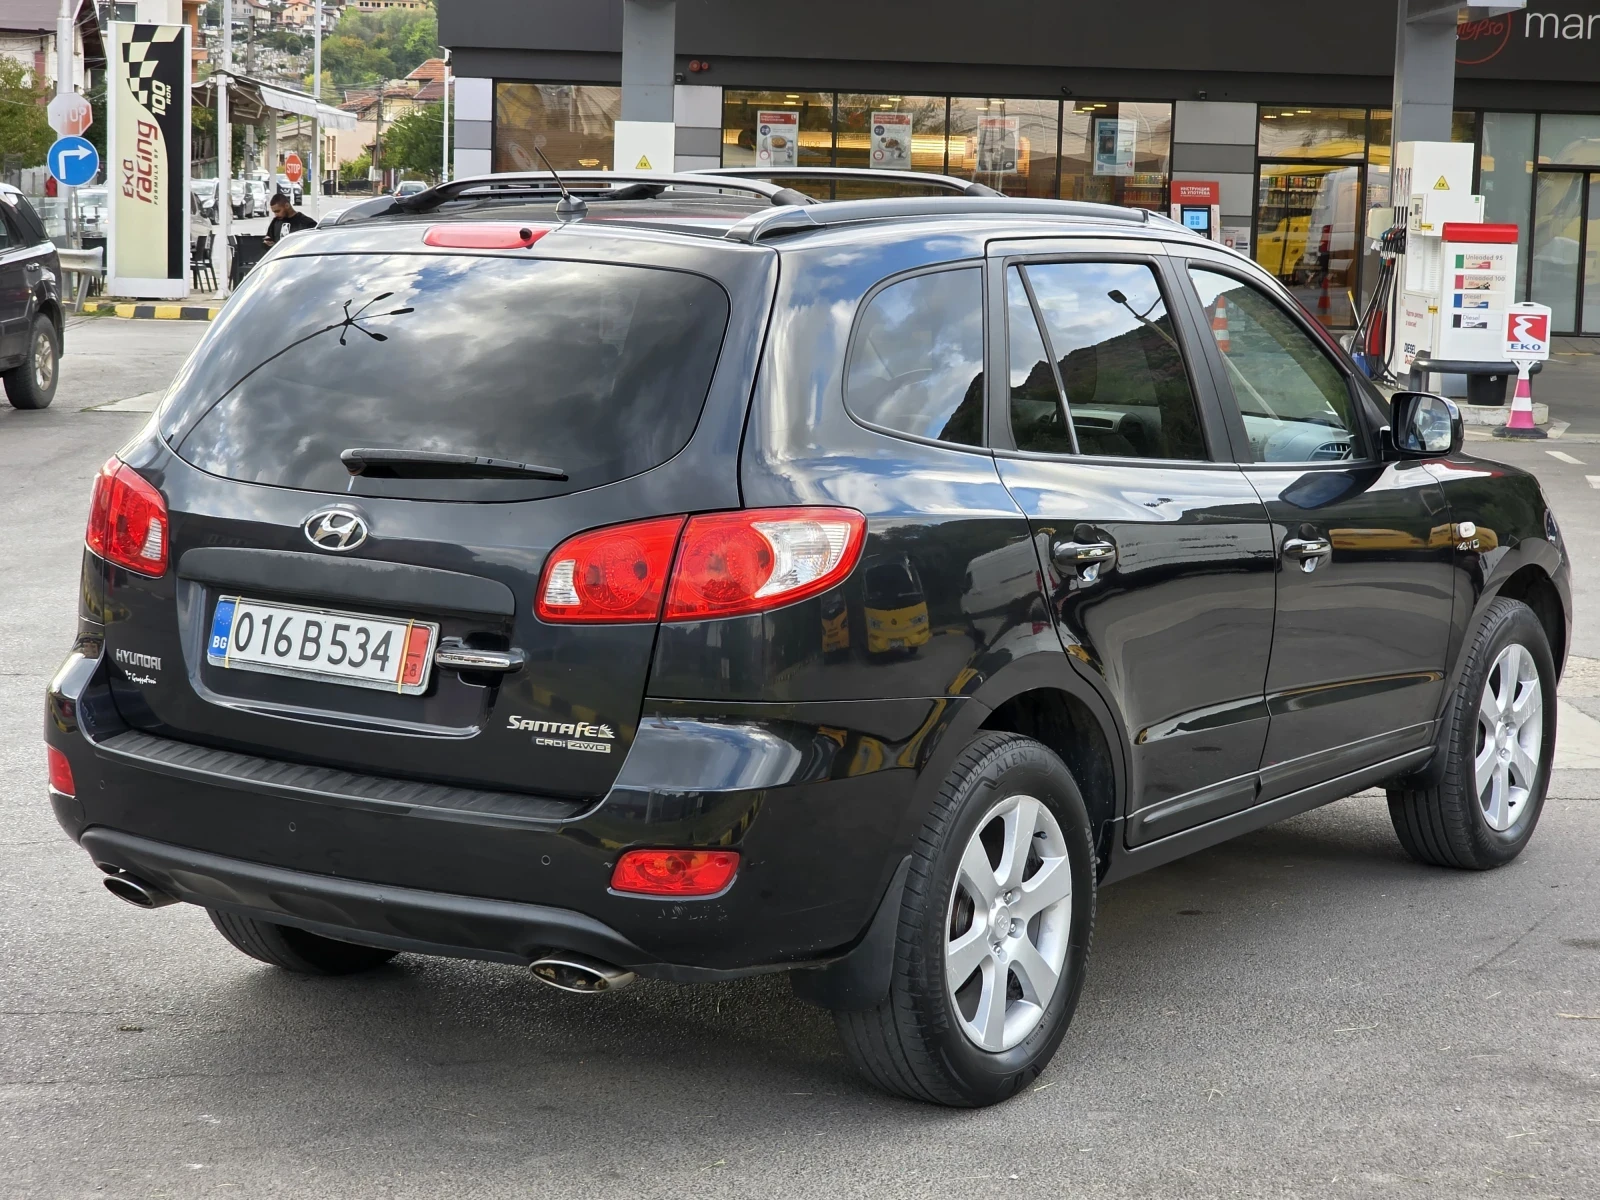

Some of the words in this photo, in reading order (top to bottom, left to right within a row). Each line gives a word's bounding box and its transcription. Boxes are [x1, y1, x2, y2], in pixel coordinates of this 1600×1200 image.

[152, 80, 166, 116] 100
[136, 119, 159, 204] racing
[286, 163, 301, 174] STOP
[1510, 343, 1541, 351] EKO
[212, 635, 228, 649] BG
[234, 611, 393, 672] 016B534
[115, 648, 162, 671] HYUNDAI
[535, 738, 566, 748] CRDi
[569, 741, 608, 752] 4WD
